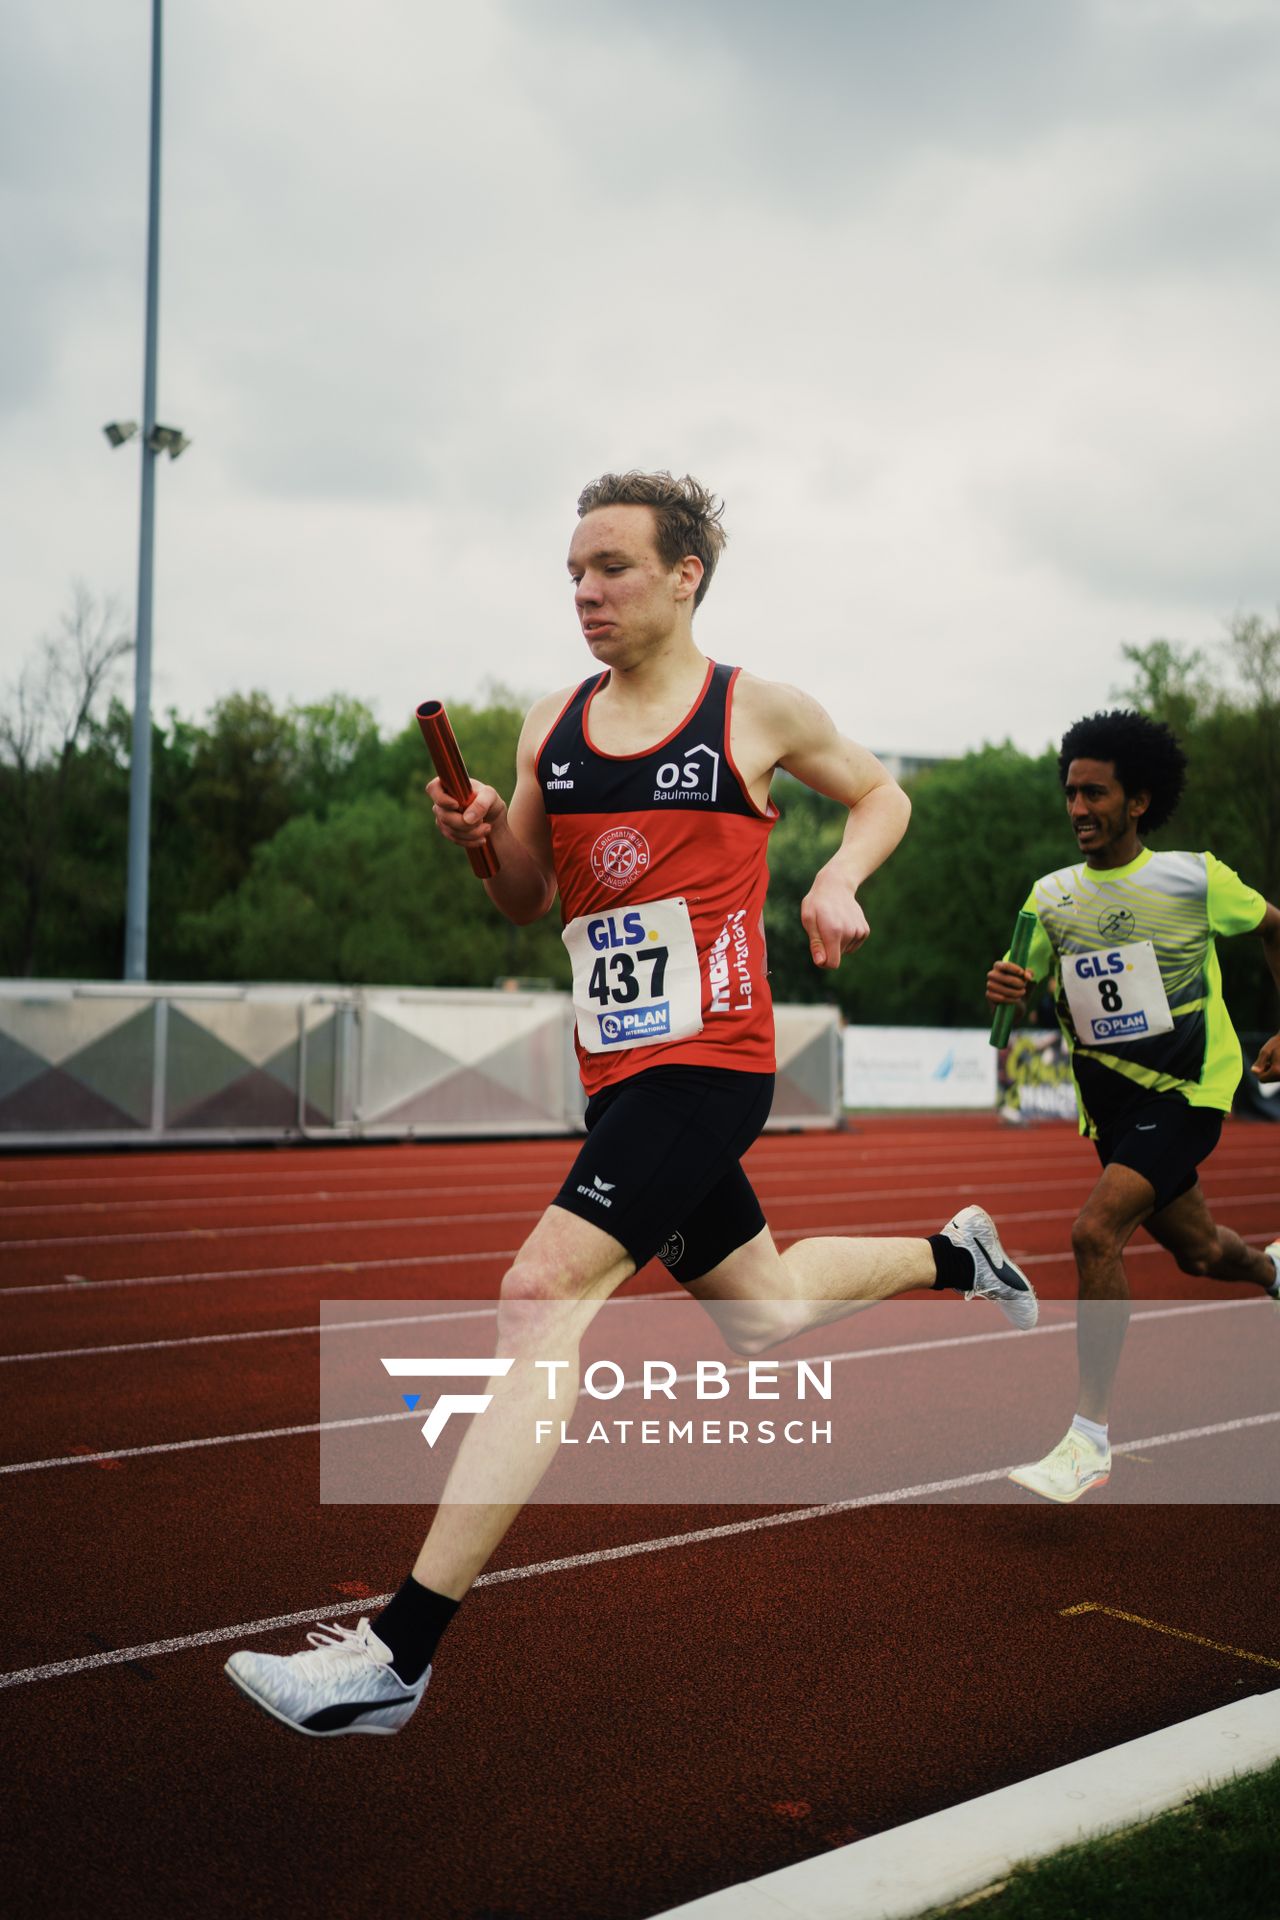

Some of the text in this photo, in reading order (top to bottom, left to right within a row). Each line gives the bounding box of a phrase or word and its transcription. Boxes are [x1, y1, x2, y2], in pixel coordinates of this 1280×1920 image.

[546, 779, 574, 790] erima
[656, 762, 700, 789] OS
[588, 946, 669, 1006] 437
[1098, 979, 1123, 1013] 8
[623, 1009, 667, 1029] PLAN
[1112, 1015, 1145, 1030] PLAN
[625, 1025, 667, 1036] INTERNATIONAL
[577, 1184, 612, 1208] erima
